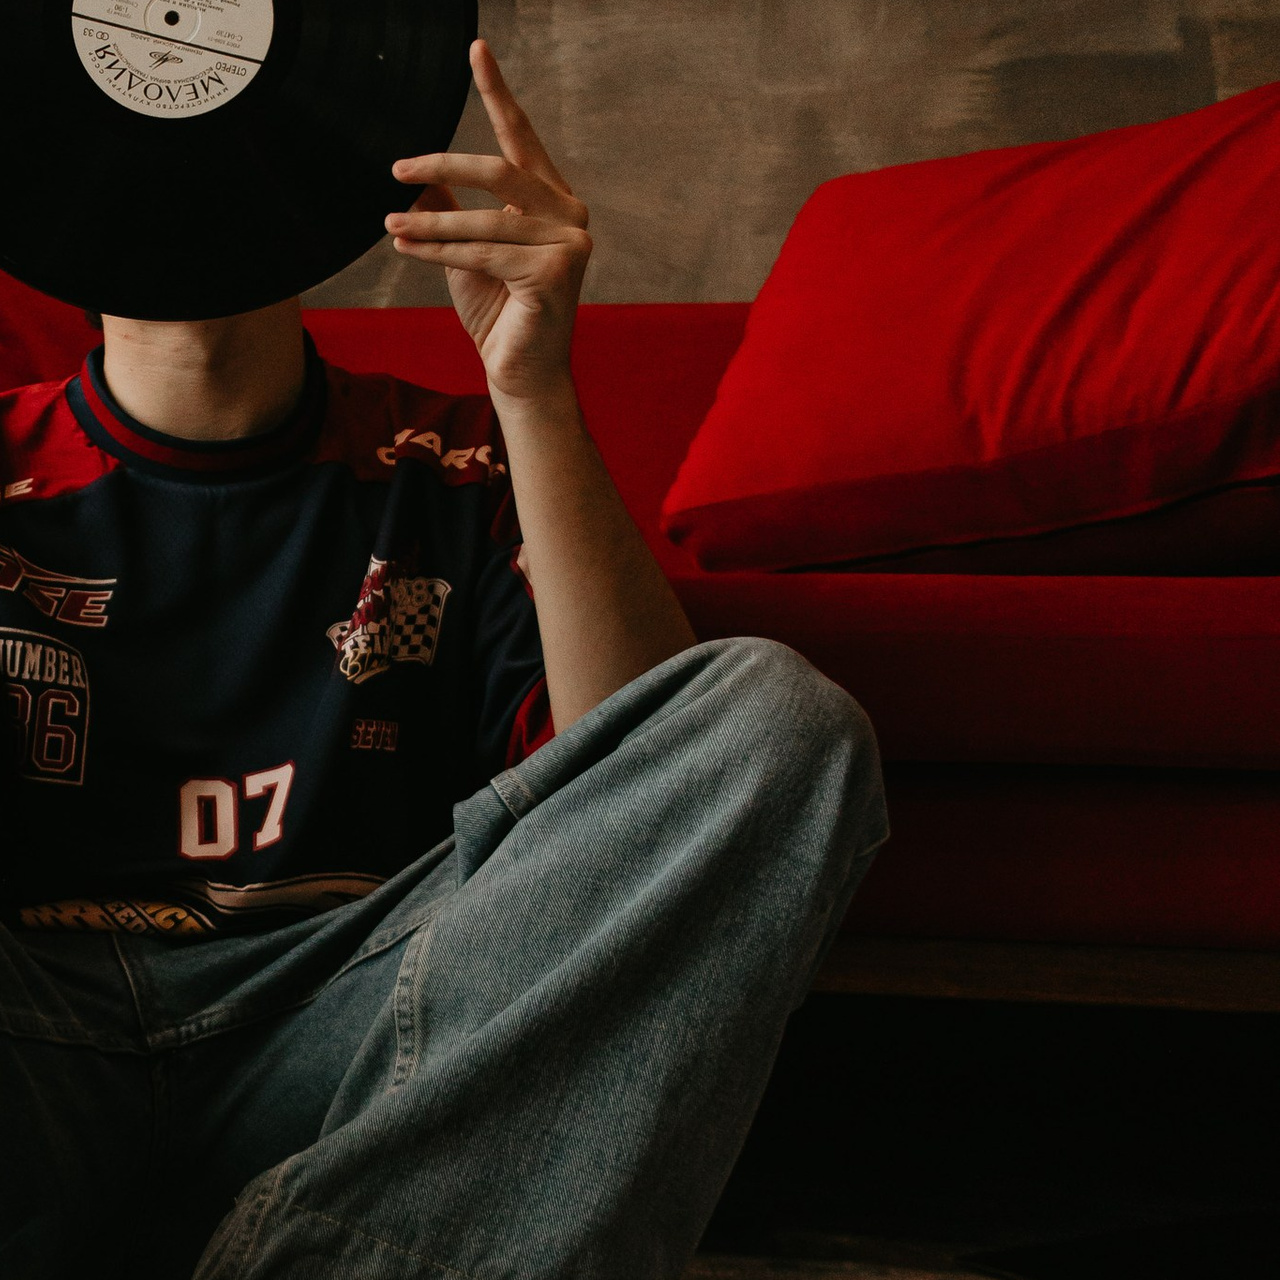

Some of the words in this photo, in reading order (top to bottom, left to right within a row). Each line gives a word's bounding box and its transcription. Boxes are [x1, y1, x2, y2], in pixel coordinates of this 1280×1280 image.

[82, 26, 94, 37] 33
[93, 44, 225, 103] МЕЛОДИЯ
[214, 60, 247, 77] СТЕРЕО
[155, 86, 228, 109] МИНИСТЕРСТВО
[178, 759, 296, 861] 07
